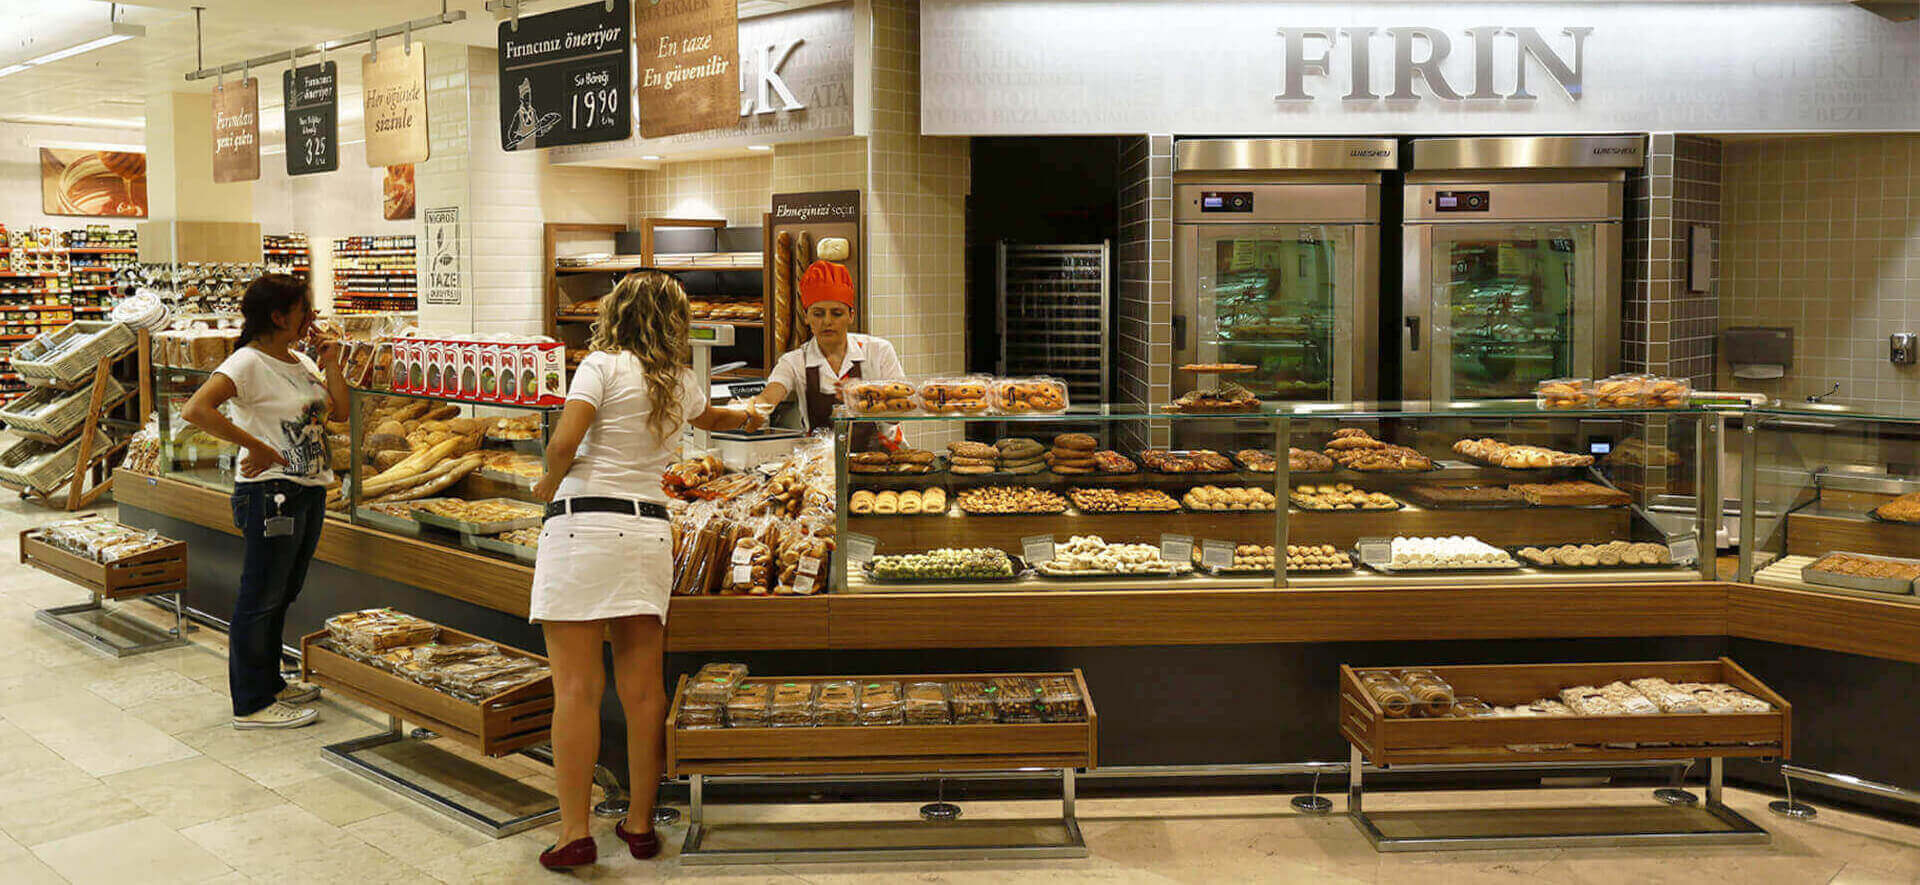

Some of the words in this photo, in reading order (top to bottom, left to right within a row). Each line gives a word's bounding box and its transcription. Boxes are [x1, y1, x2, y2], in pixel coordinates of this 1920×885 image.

[506, 41, 561, 58] Fırıncınız
[565, 24, 621, 50] öneriyor
[657, 36, 677, 58] En
[682, 34, 712, 53] taze
[643, 68, 661, 87] En
[664, 55, 729, 90] güvenilir
[1274, 26, 1594, 102] FIRIN
[366, 89, 383, 109] Her
[375, 107, 413, 132] sizinle
[215, 132, 233, 154] yeni
[430, 272, 457, 288] TAZE
